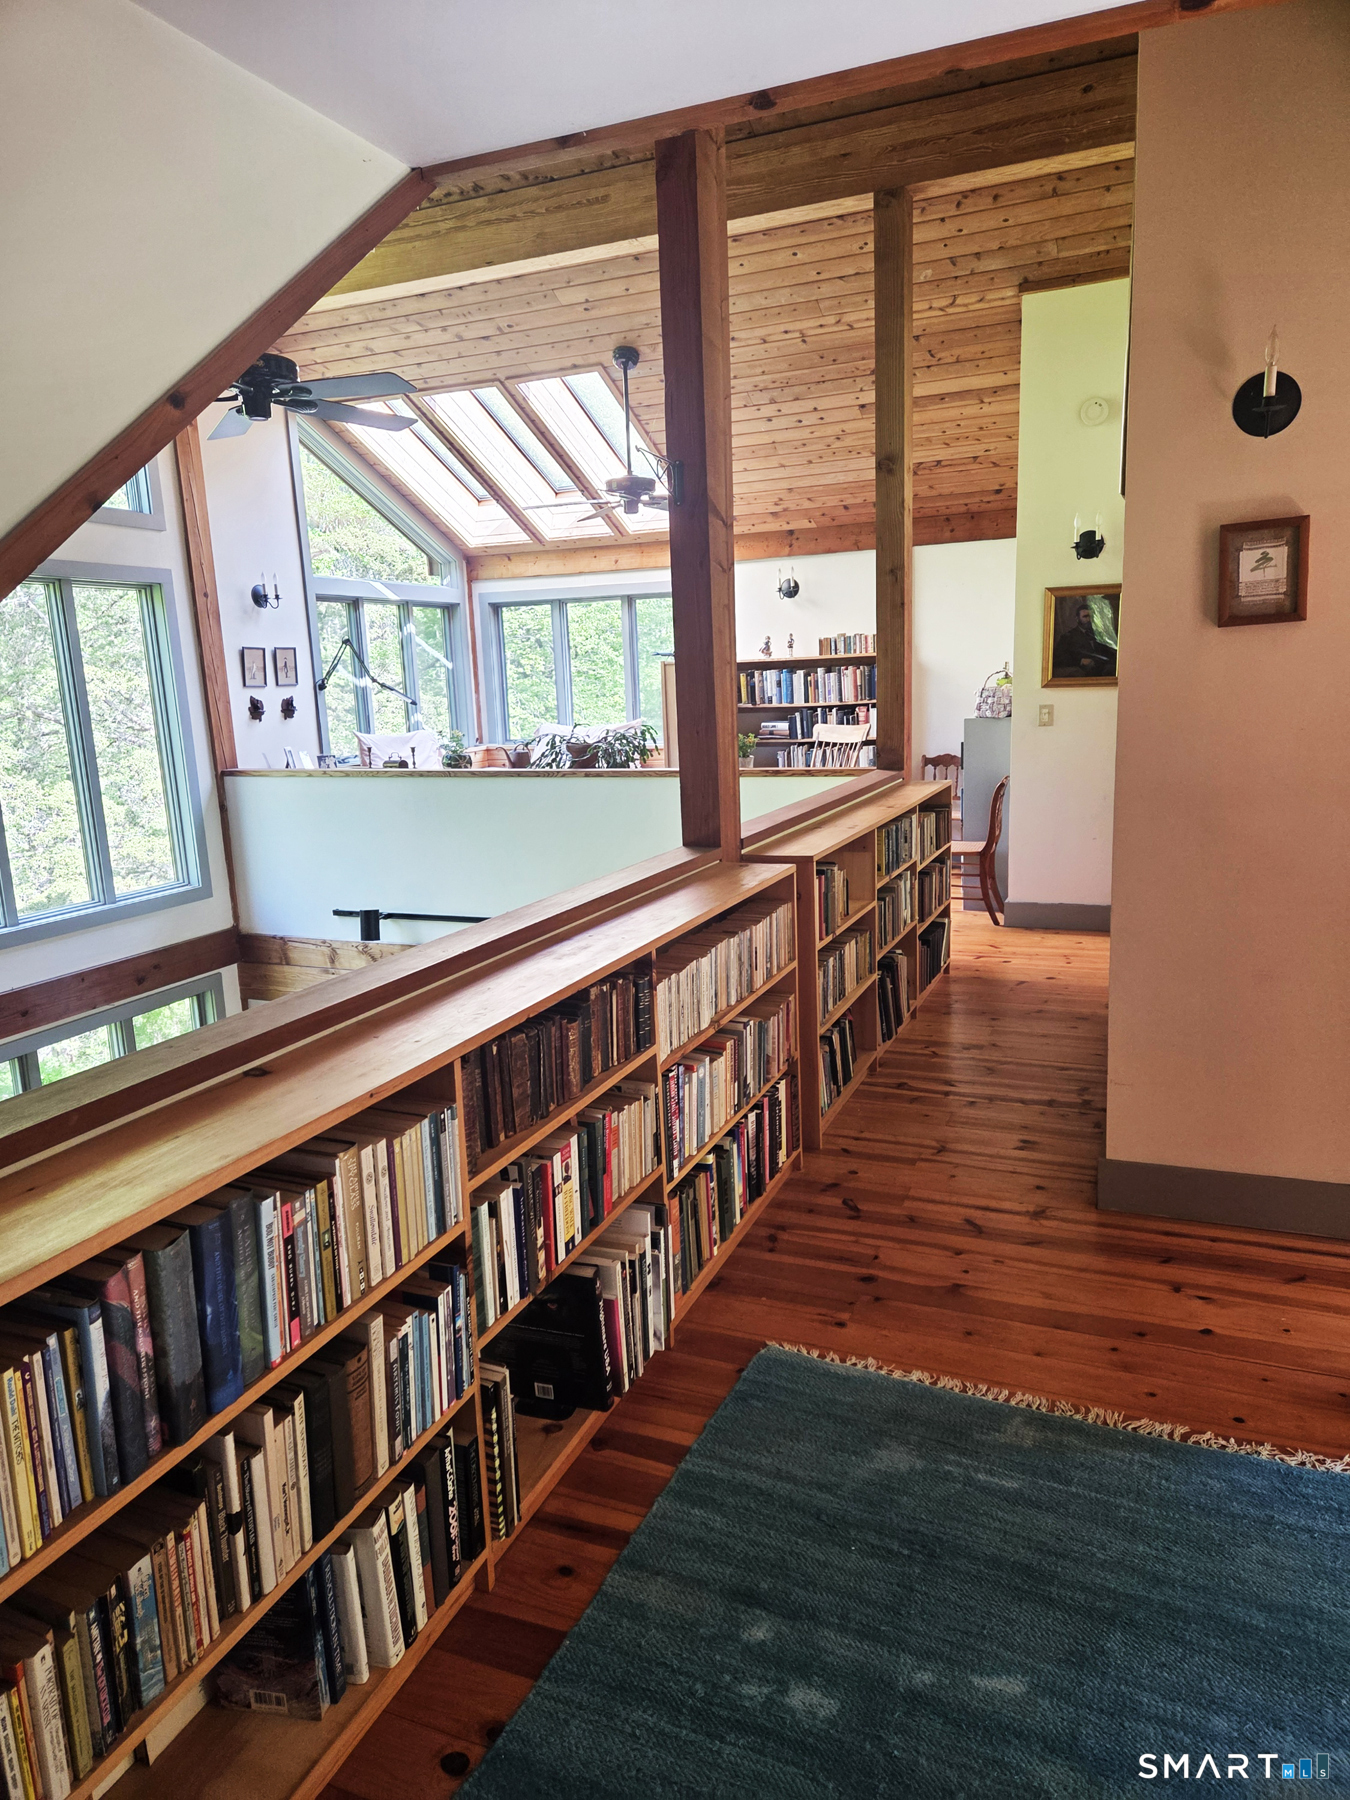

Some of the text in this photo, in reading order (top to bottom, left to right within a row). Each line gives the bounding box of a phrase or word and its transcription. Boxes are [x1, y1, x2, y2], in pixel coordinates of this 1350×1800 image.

[391, 1364, 400, 1404] ARTEMIS
[11, 1418, 19, 1435] THE
[13, 1432, 23, 1466] WITCHES
[216, 1483, 224, 1510] Bontemps
[218, 1510, 230, 1563] Black Thunder
[448, 1502, 457, 1541] 2061:
[381, 1553, 394, 1600] BARBARA
[388, 1606, 400, 1648] TUCHMAN
[324, 1564, 338, 1634] REVOLUTION
[333, 1647, 342, 1677] TIME
[45, 1666, 57, 1708] PORTRAIT
[41, 1699, 50, 1729] ARTIST
